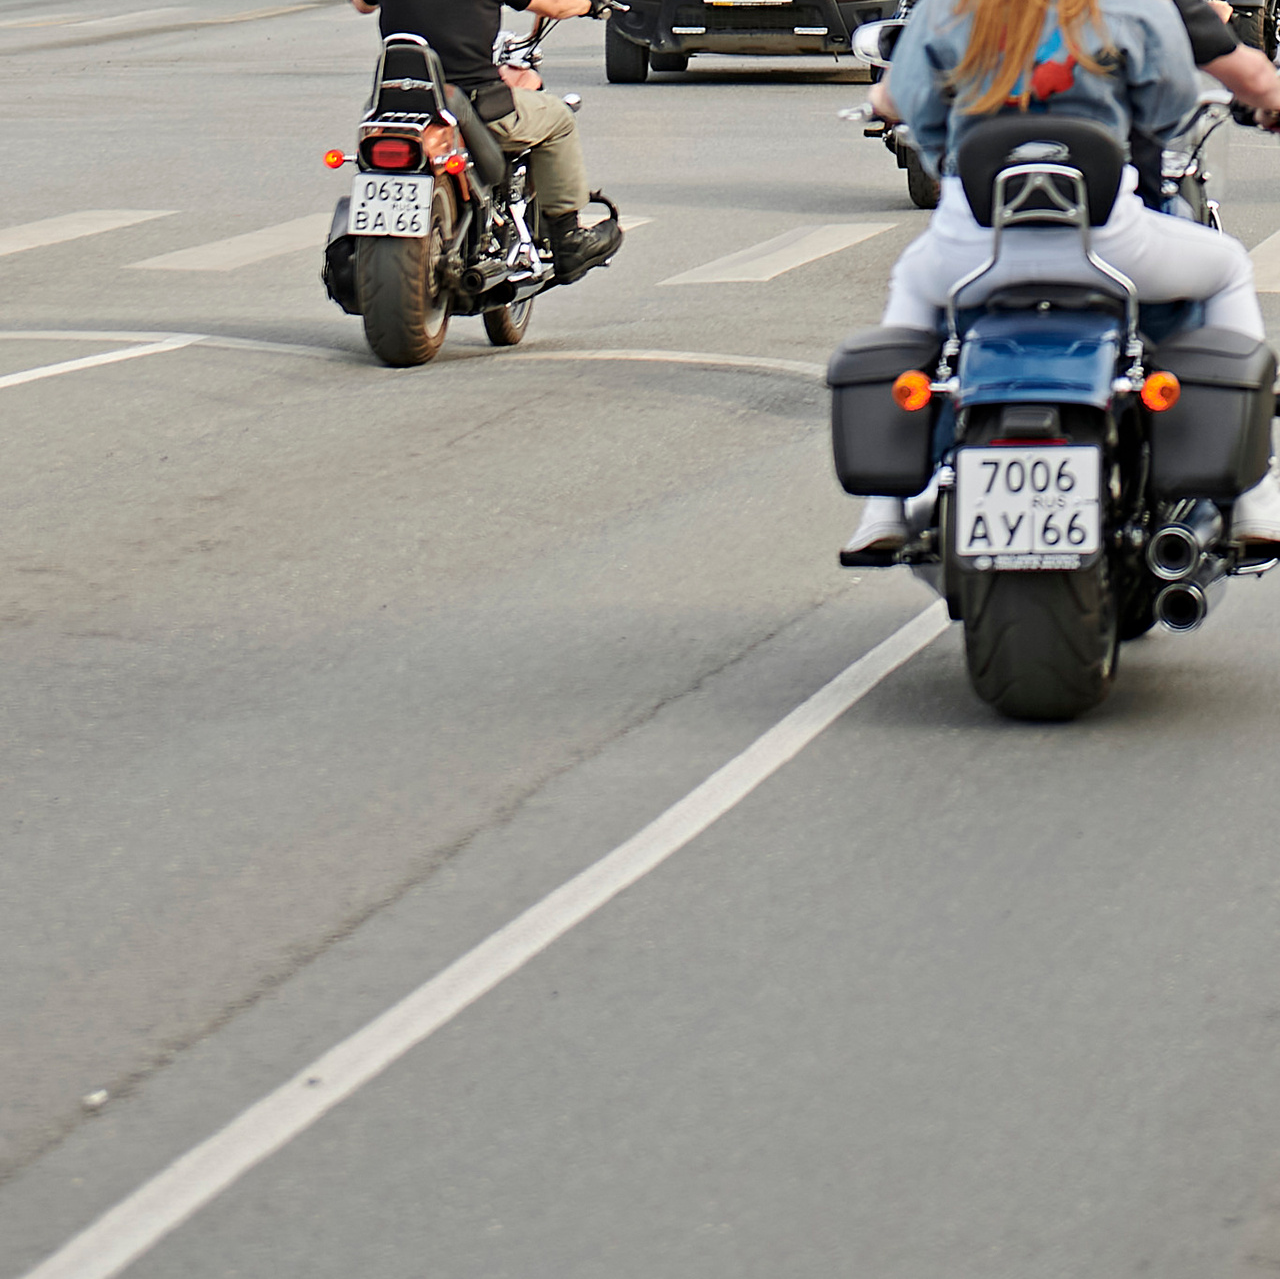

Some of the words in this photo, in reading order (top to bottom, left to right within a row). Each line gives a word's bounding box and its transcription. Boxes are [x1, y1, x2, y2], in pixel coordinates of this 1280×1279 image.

[364, 181, 418, 202] 0633
[395, 212, 422, 233] 66
[980, 457, 1076, 493] 7006
[1041, 510, 1087, 546] 66
